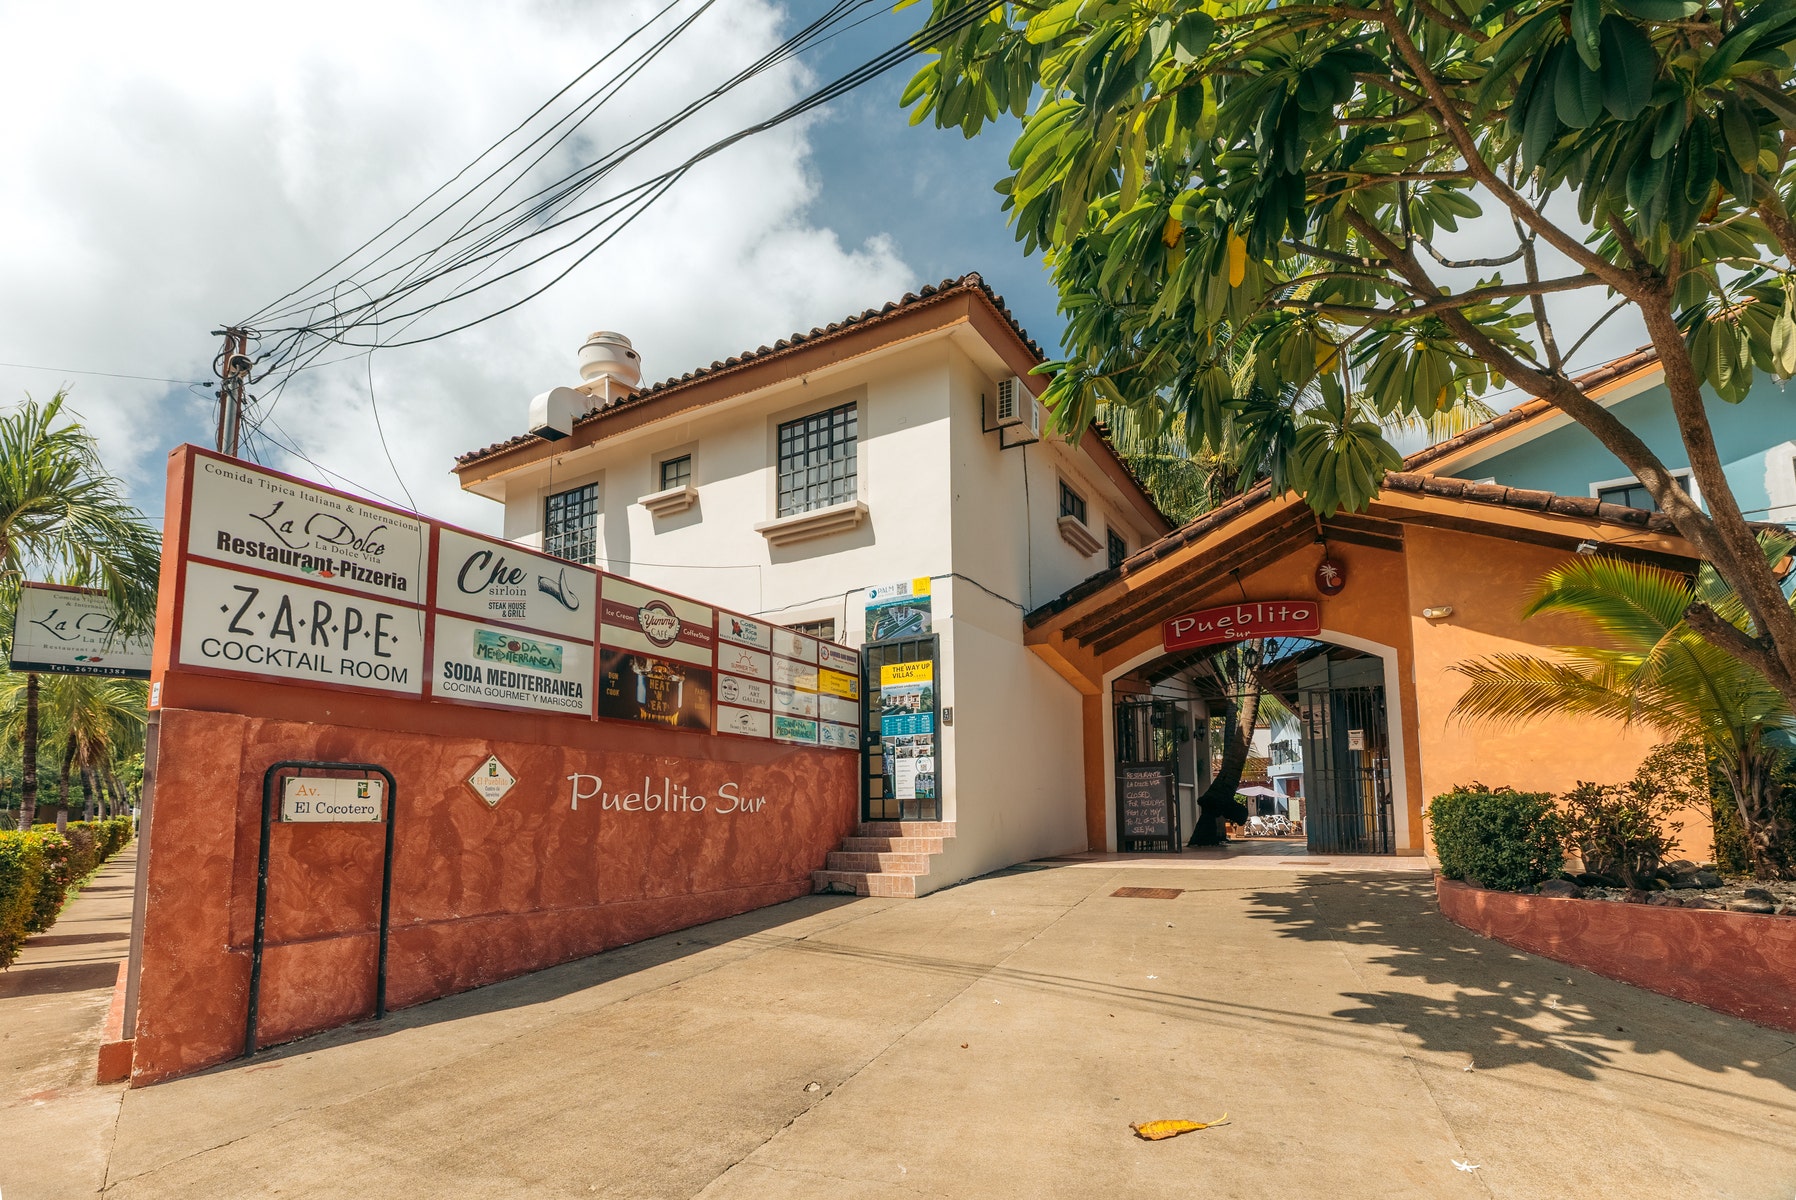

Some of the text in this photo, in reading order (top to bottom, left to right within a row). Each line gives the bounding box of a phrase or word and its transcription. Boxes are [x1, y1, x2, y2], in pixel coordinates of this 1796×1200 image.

[204, 463, 253, 485] Comida
[300, 490, 341, 510] Italiana
[345, 504, 355, 514] &
[249, 501, 388, 556] La Dolce
[315, 541, 381, 564] La Dolce Vita
[217, 530, 407, 592] Restaurant-Pizzeria
[457, 550, 527, 594] Che
[488, 585, 527, 597] sirloin
[488, 602, 526, 610] STEAK HOUSE
[508, 609, 526, 618] GRILL
[605, 608, 635, 622] Ice Cream
[30, 609, 81, 641] La
[644, 614, 676, 629] Yummy
[740, 619, 757, 630] Costa
[1171, 604, 1310, 639] Pueblito Sur
[745, 627, 757, 636] Rica
[43, 644, 88, 652] Restaurant
[201, 638, 408, 684] COCKTAIL ROOM
[50, 664, 126, 675] Tel. 2670-1384
[444, 661, 583, 699] SODA MEDITERRANEA
[649, 678, 670, 692] HEAT
[443, 682, 583, 709] COCINA GOURMET Y MARISCOS
[742, 696, 767, 705] GALLERY
[477, 777, 508, 785] El Pueblito
[1126, 771, 1160, 779] RESTAURANTE
[295, 784, 320, 797] Av.
[567, 772, 766, 814] Pueblito Sur
[1127, 791, 1150, 799] CLOSED
[294, 801, 375, 814] El Cocotero
[1132, 826, 1145, 834] SEE
